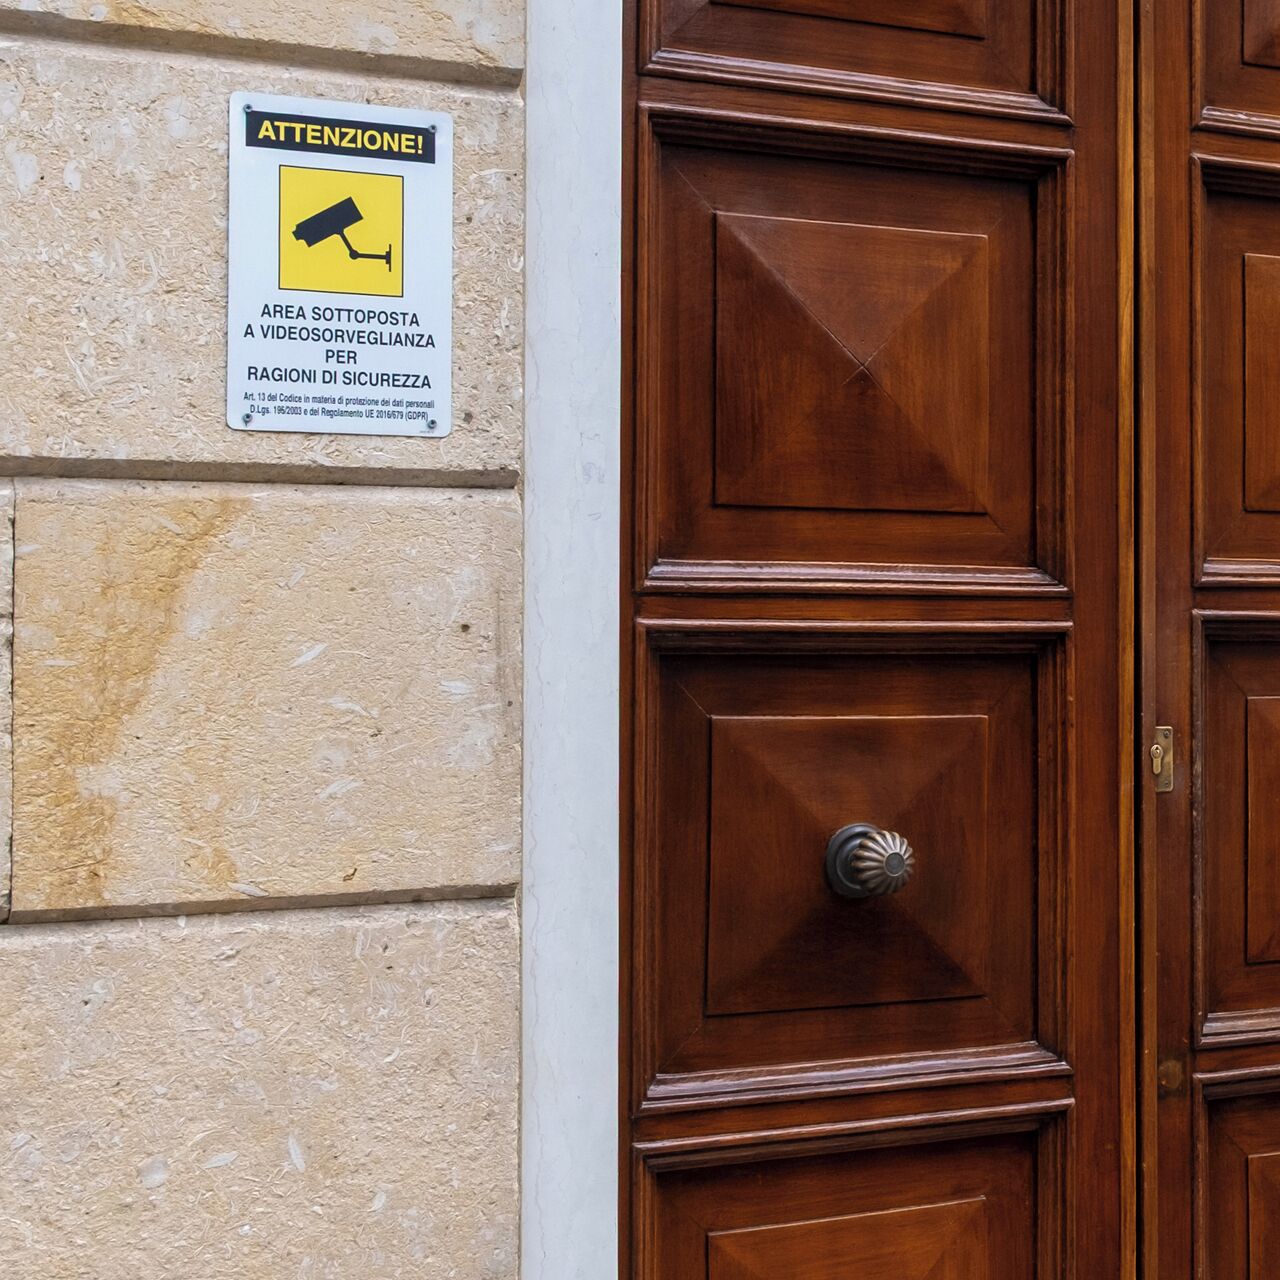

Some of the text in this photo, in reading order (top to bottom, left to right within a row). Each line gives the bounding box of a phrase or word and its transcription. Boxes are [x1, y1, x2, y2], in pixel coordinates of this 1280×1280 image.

[257, 119, 423, 155] ATTENZIONE!
[260, 303, 420, 327] AREA SOTTOPOSTA
[243, 323, 436, 349] A VIDEOSORVEGLIANZA
[325, 349, 358, 365] PER
[247, 366, 432, 389] RAGIONI DI SICUREZZA
[243, 391, 255, 401] Art.
[258, 392, 265, 401] 13
[267, 392, 277, 402] del
[279, 393, 302, 403] Codice
[304, 394, 311, 403] in
[311, 394, 336, 405] materia
[337, 395, 344, 405] di
[345, 396, 379, 407] protezione
[392, 398, 404, 408] dati
[405, 399, 435, 410] personali
[321, 407, 363, 419] Regolamento
[365, 409, 374, 419] UE
[376, 409, 404, 420] 2016/679
[404, 411, 429, 422] (GDPR)
